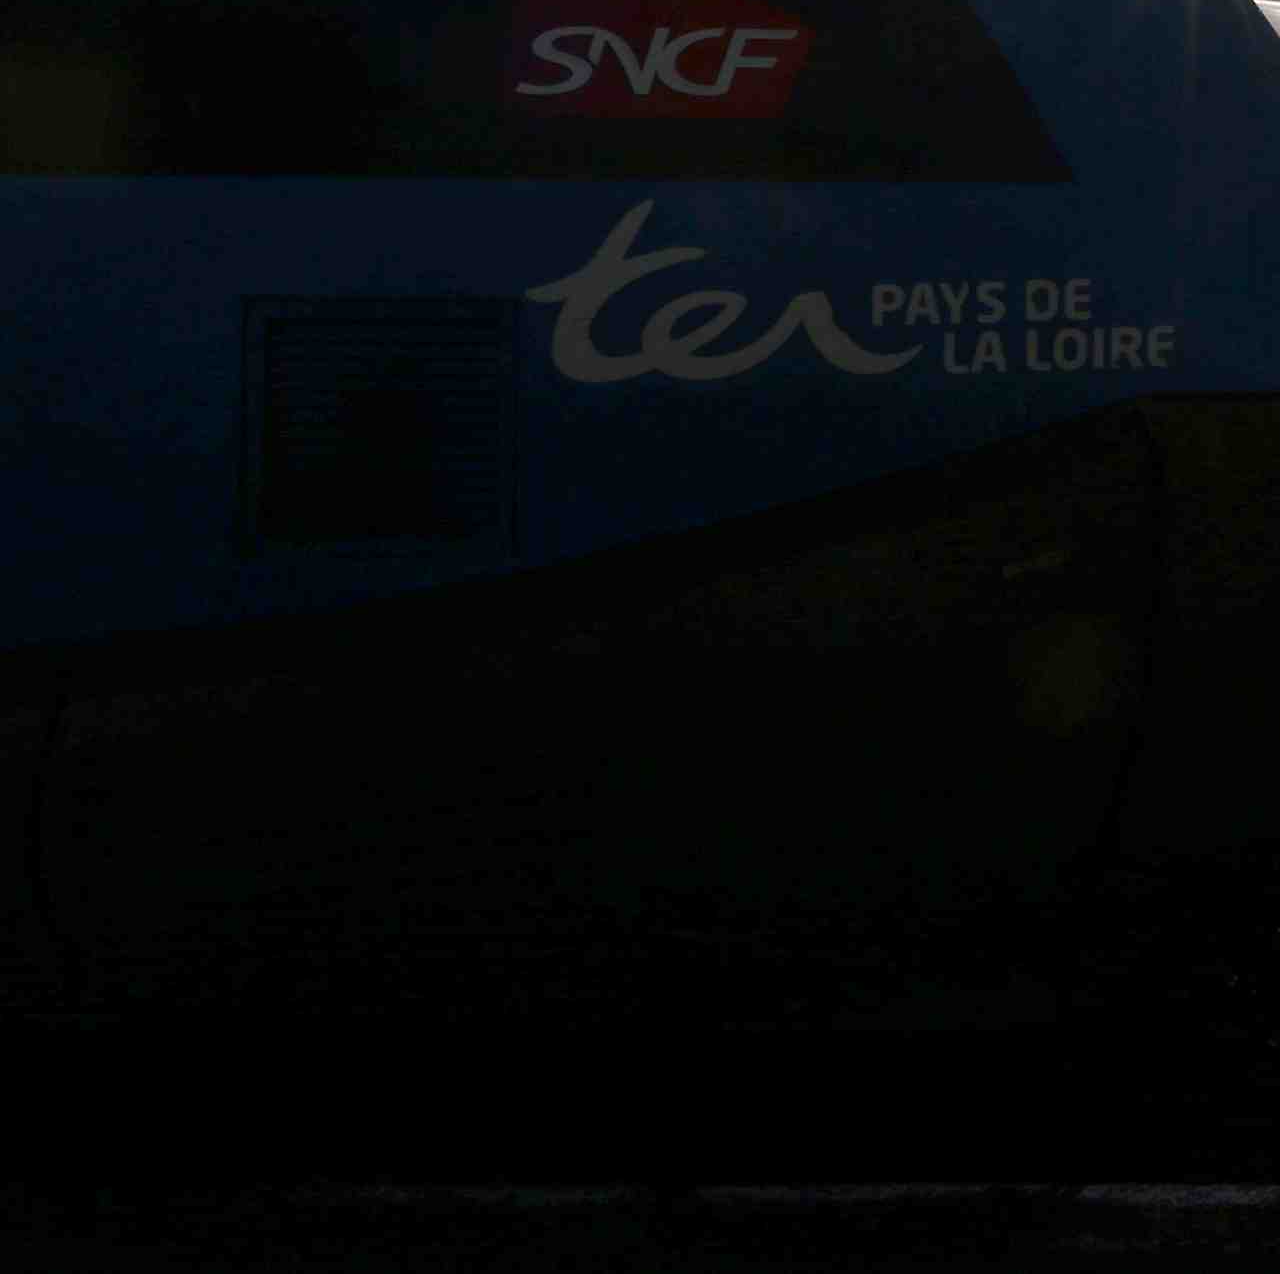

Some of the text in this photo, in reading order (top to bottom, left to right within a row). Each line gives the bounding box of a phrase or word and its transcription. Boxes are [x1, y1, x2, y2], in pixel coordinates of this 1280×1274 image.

[515, 24, 798, 96] SNCF
[525, 198, 923, 384] ter
[871, 279, 1092, 326] PAYS DE
[944, 326, 1176, 374] LA LOIRE
